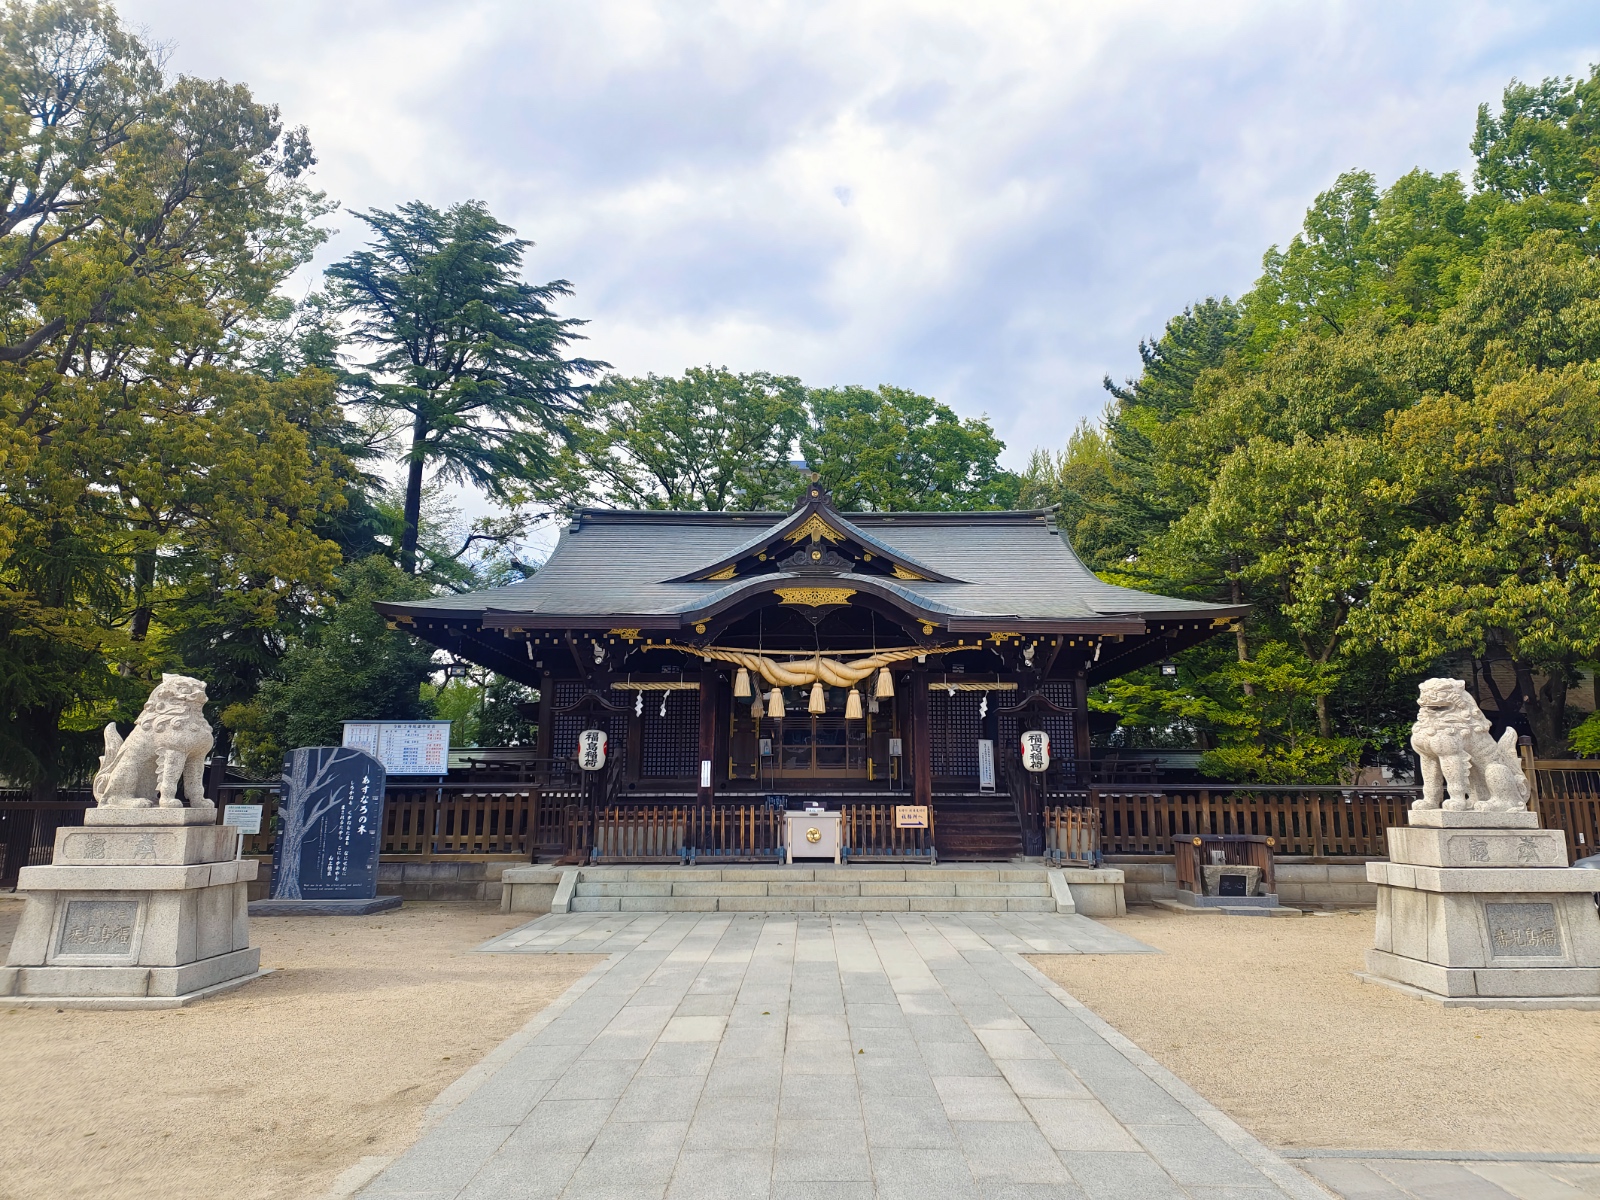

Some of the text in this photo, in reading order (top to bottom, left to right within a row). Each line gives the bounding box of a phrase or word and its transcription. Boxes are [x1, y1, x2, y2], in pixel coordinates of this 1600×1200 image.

[584, 731, 600, 768] 福島稲荷
[1027, 733, 1045, 769] 福島稲荷
[357, 775, 371, 835] あすなろの木
